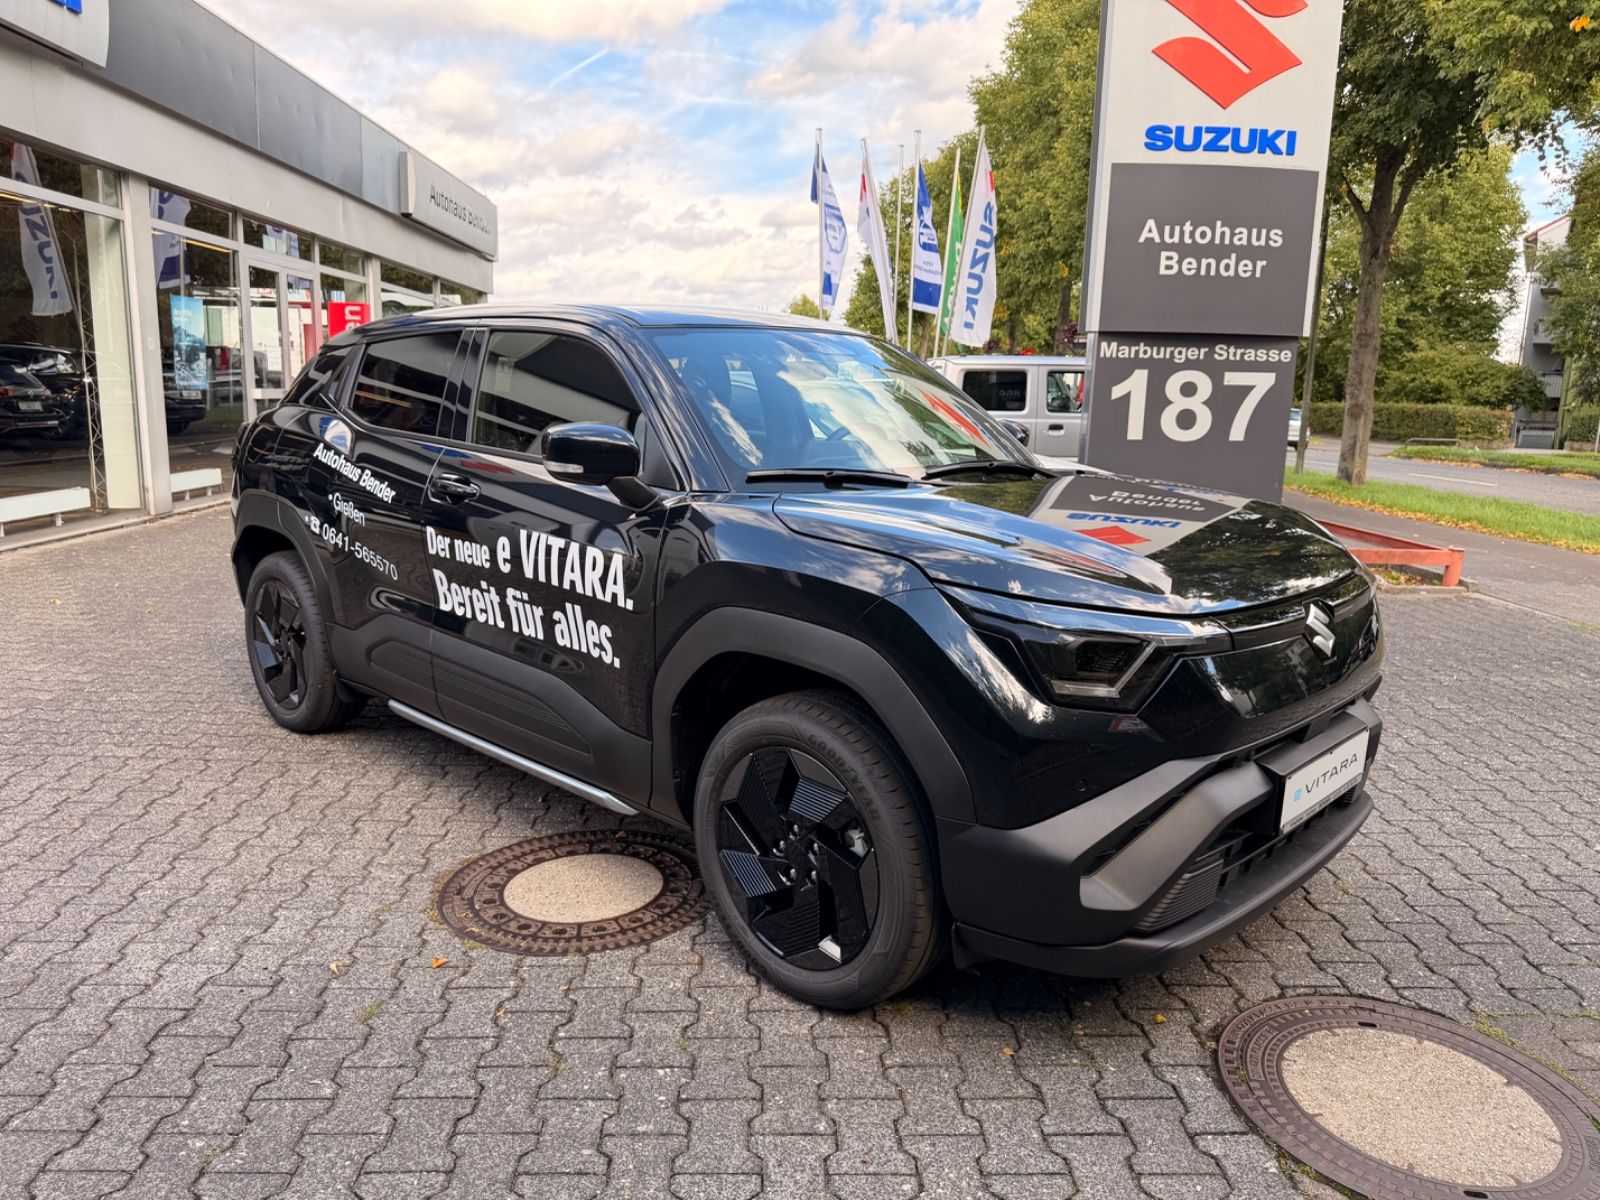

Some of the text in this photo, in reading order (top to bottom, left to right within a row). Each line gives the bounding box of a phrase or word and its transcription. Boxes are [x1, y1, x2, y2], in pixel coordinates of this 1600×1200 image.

[1143, 124, 1297, 156] SUZUKI
[429, 184, 466, 222] Autohaus
[1138, 218, 1284, 248] Autohaus
[1158, 251, 1267, 278] Bender
[1099, 341, 1293, 364] Marburger Strasse
[1110, 368, 1277, 442] 187
[313, 442, 396, 504] Autohaus Bender
[333, 493, 366, 527] Gießen
[322, 517, 398, 581] 0641-565570
[426, 525, 635, 611] Der neue e VITARA.
[432, 569, 621, 669] Bereit für alles.
[1305, 753, 1358, 794] VITARA
